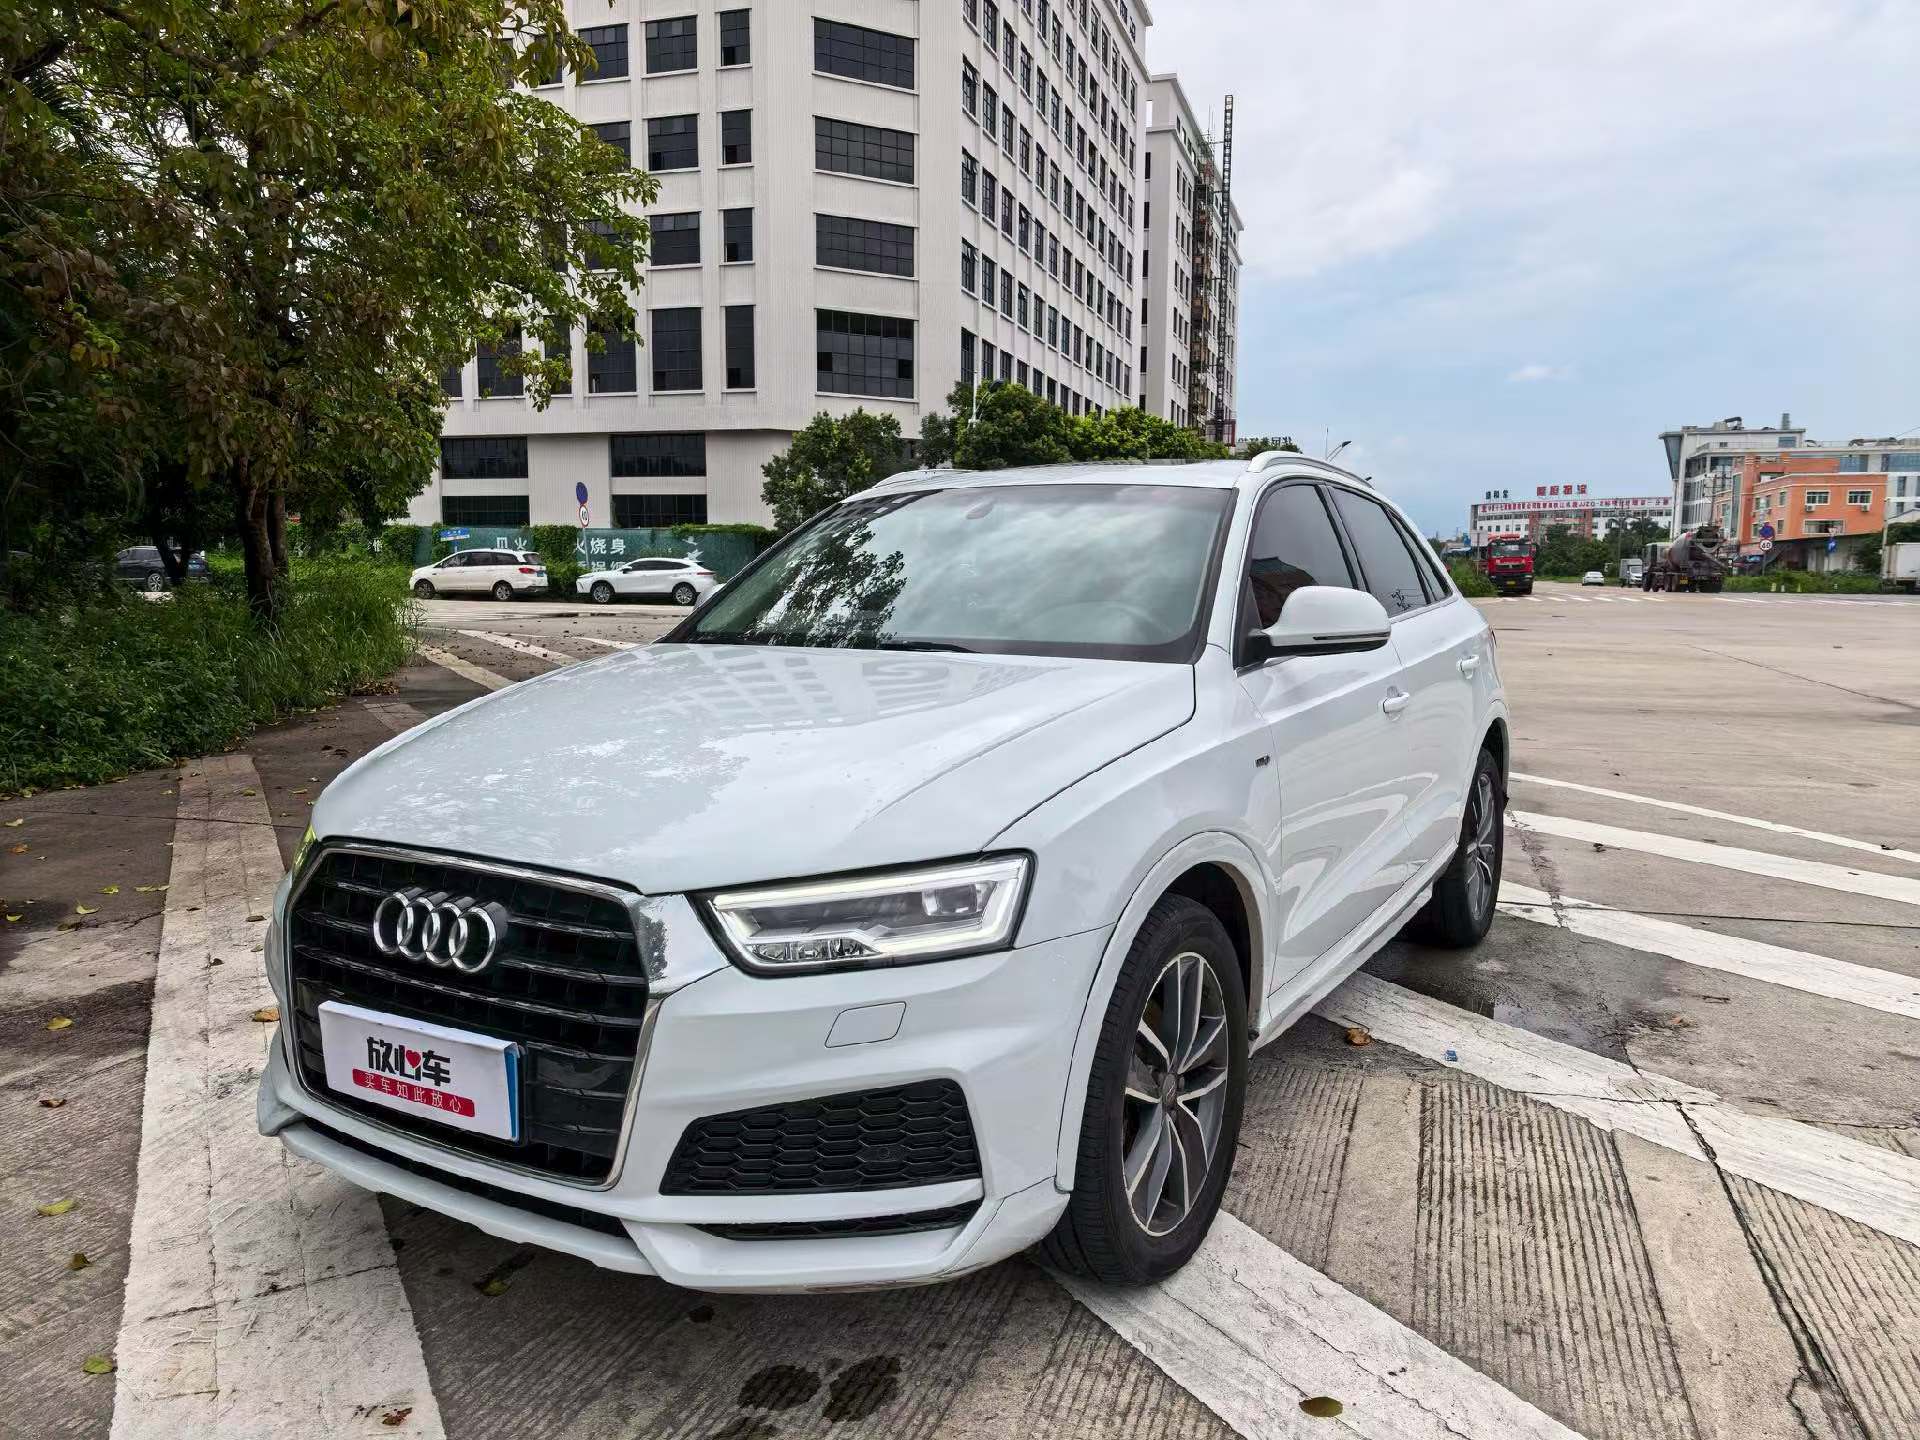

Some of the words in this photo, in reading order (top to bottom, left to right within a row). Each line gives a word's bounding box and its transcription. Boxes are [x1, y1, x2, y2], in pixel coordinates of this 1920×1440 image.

[366, 1036, 451, 1087] 放心车
[364, 1072, 462, 1113] 买车如此放心
